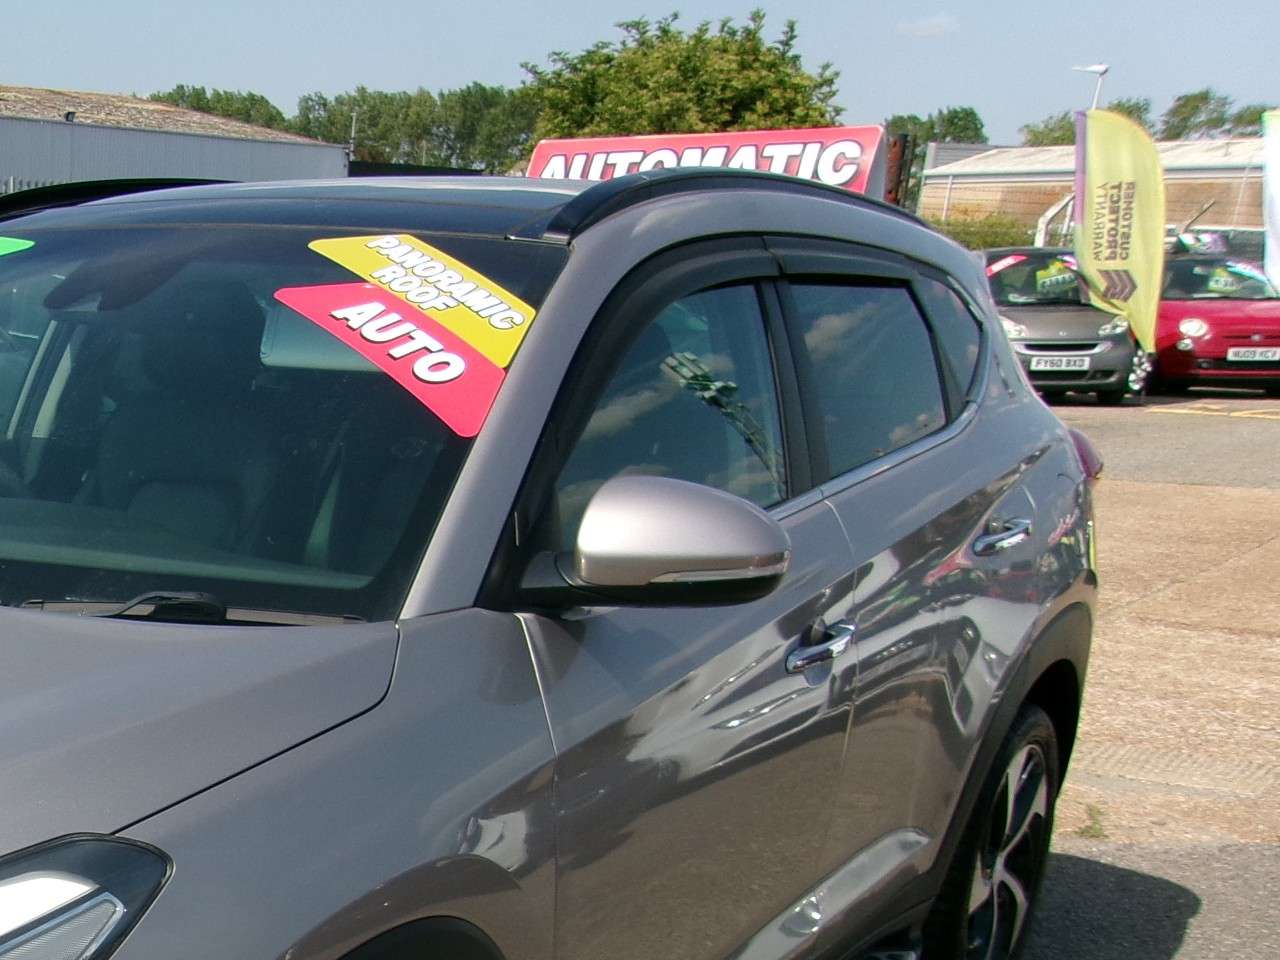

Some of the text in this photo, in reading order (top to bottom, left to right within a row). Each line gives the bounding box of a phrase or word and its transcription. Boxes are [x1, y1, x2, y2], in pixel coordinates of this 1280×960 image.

[540, 139, 863, 186] AUTOMATIC
[365, 234, 525, 331] PANORAMIC
[370, 265, 460, 313] ROOF
[327, 300, 468, 385] AUTO
